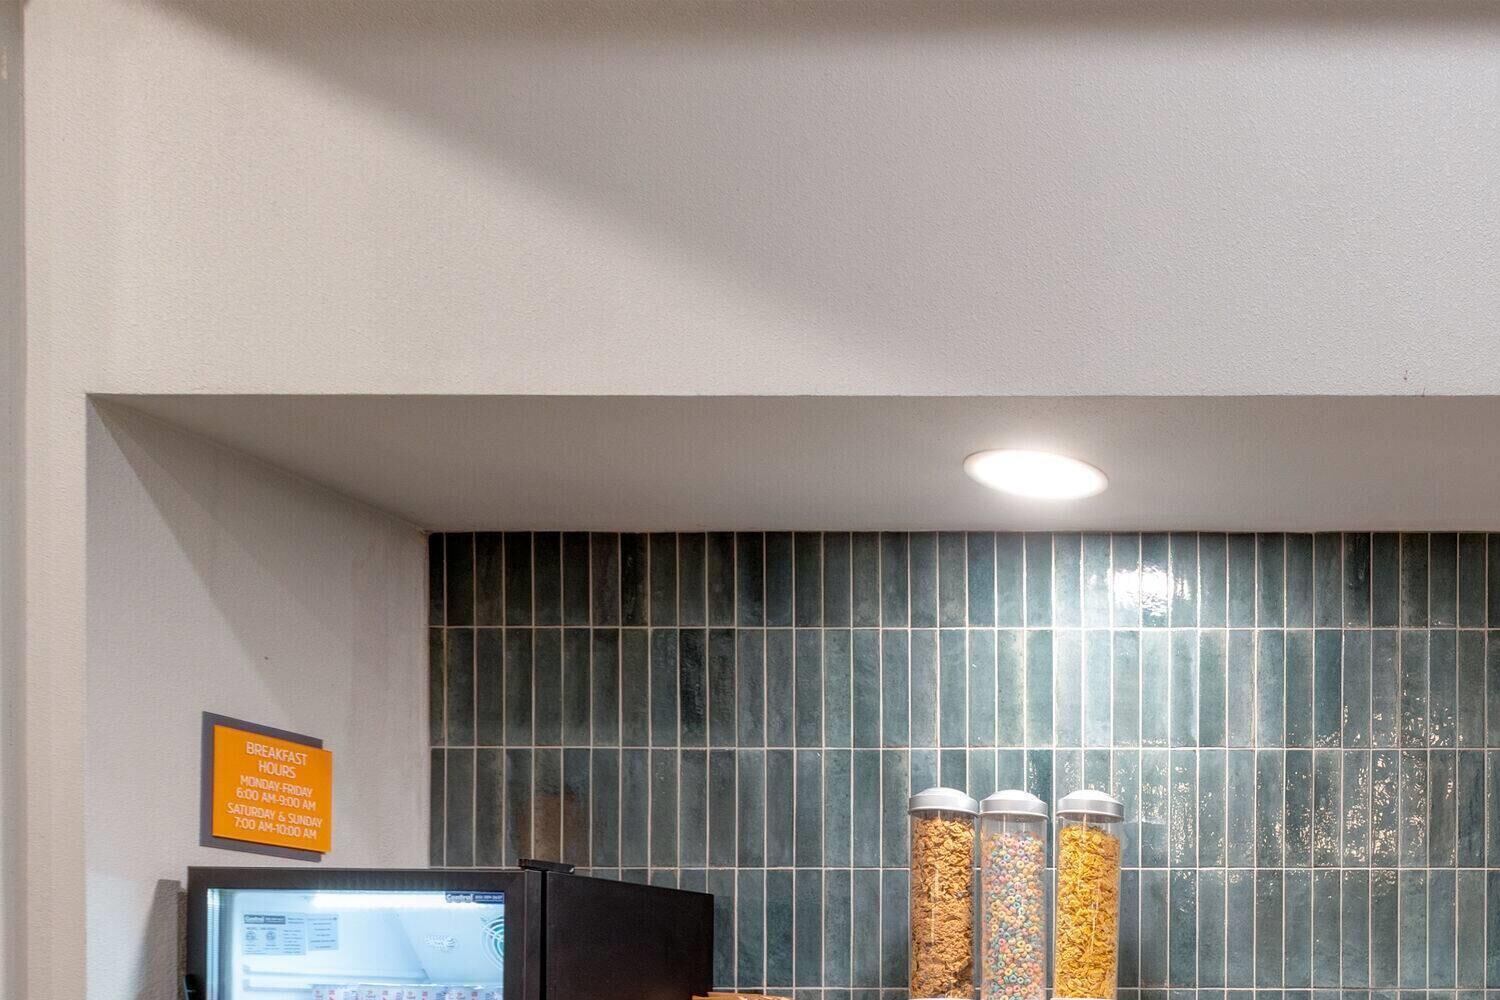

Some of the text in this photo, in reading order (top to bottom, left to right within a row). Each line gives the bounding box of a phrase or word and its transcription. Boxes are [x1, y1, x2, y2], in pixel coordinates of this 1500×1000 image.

[246, 741, 308, 766] BREAKFAST
[258, 760, 297, 779] HOURS
[235, 787, 259, 801] 6:00
[302, 800, 316, 812] AM
[227, 802, 323, 828] SATURDAY & SUNDAY
[234, 816, 256, 830] 7:00
[303, 829, 317, 840] AM
